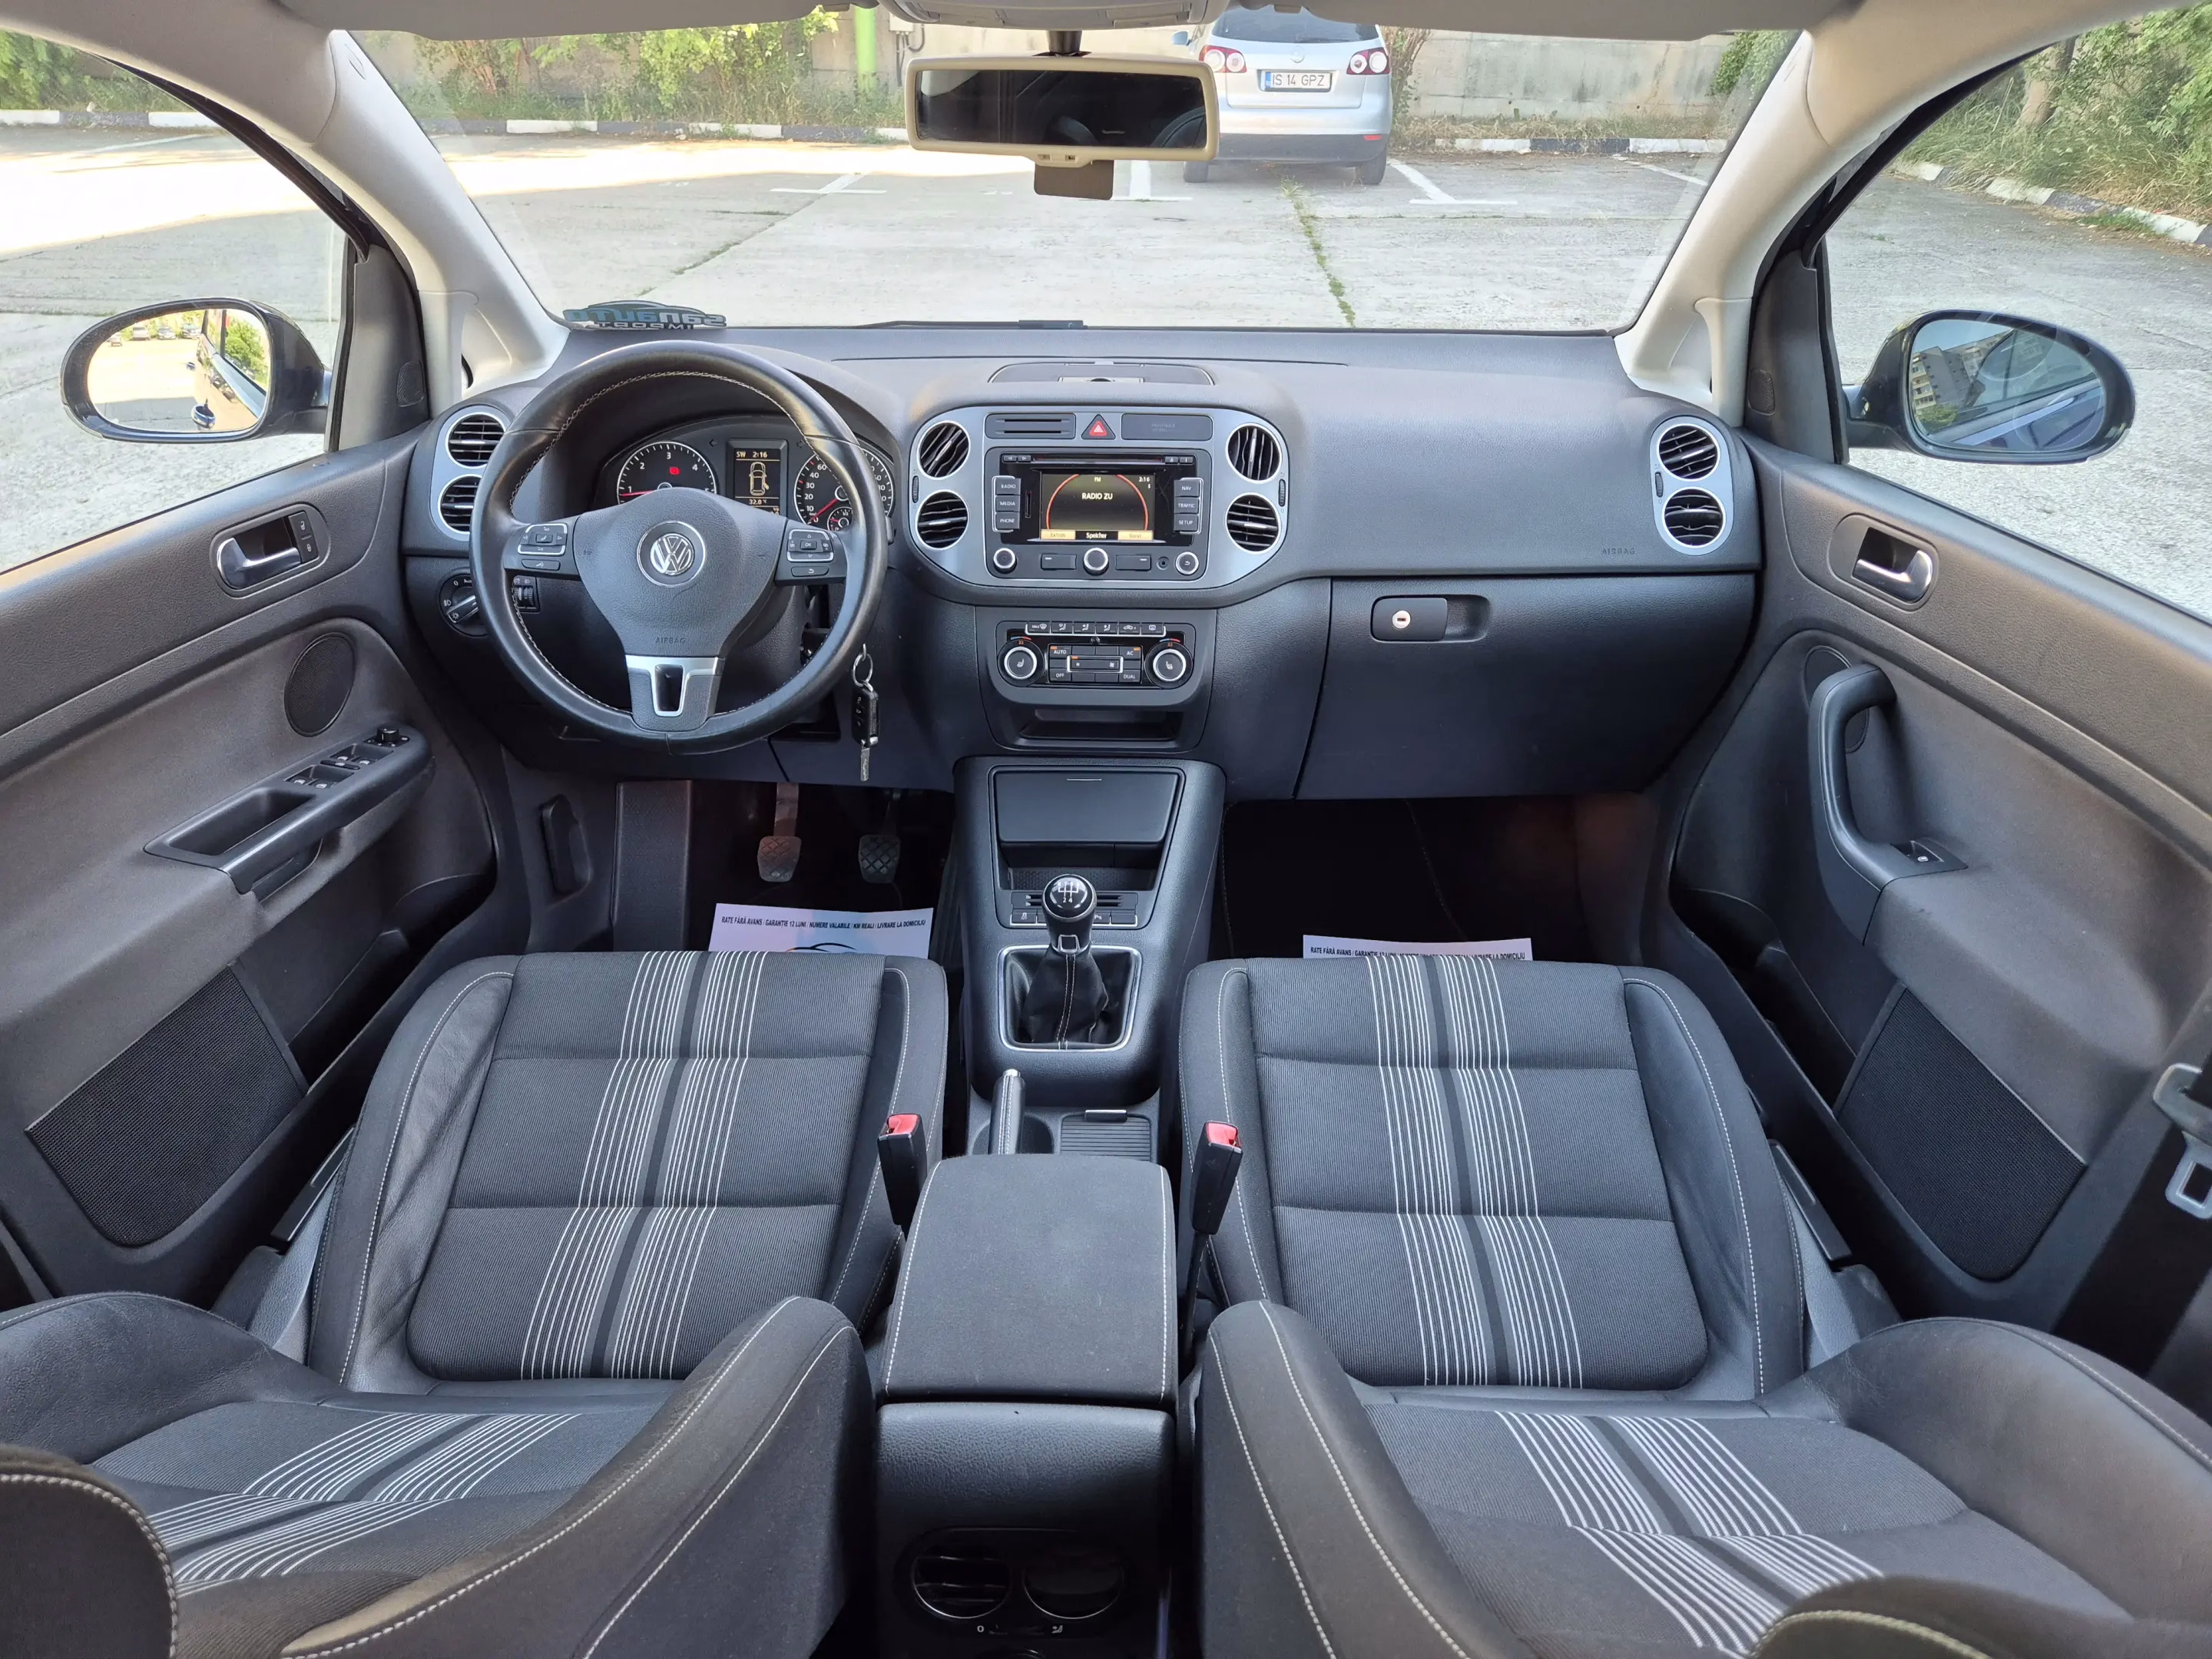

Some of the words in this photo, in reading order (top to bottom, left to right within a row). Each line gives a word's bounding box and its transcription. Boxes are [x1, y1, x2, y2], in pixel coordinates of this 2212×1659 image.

[1272, 74, 1283, 86] IS
[1287, 74, 1296, 86] 14
[1301, 75, 1325, 86] GPZ
[639, 462, 645, 470] 2
[747, 918, 762, 926] AVANS
